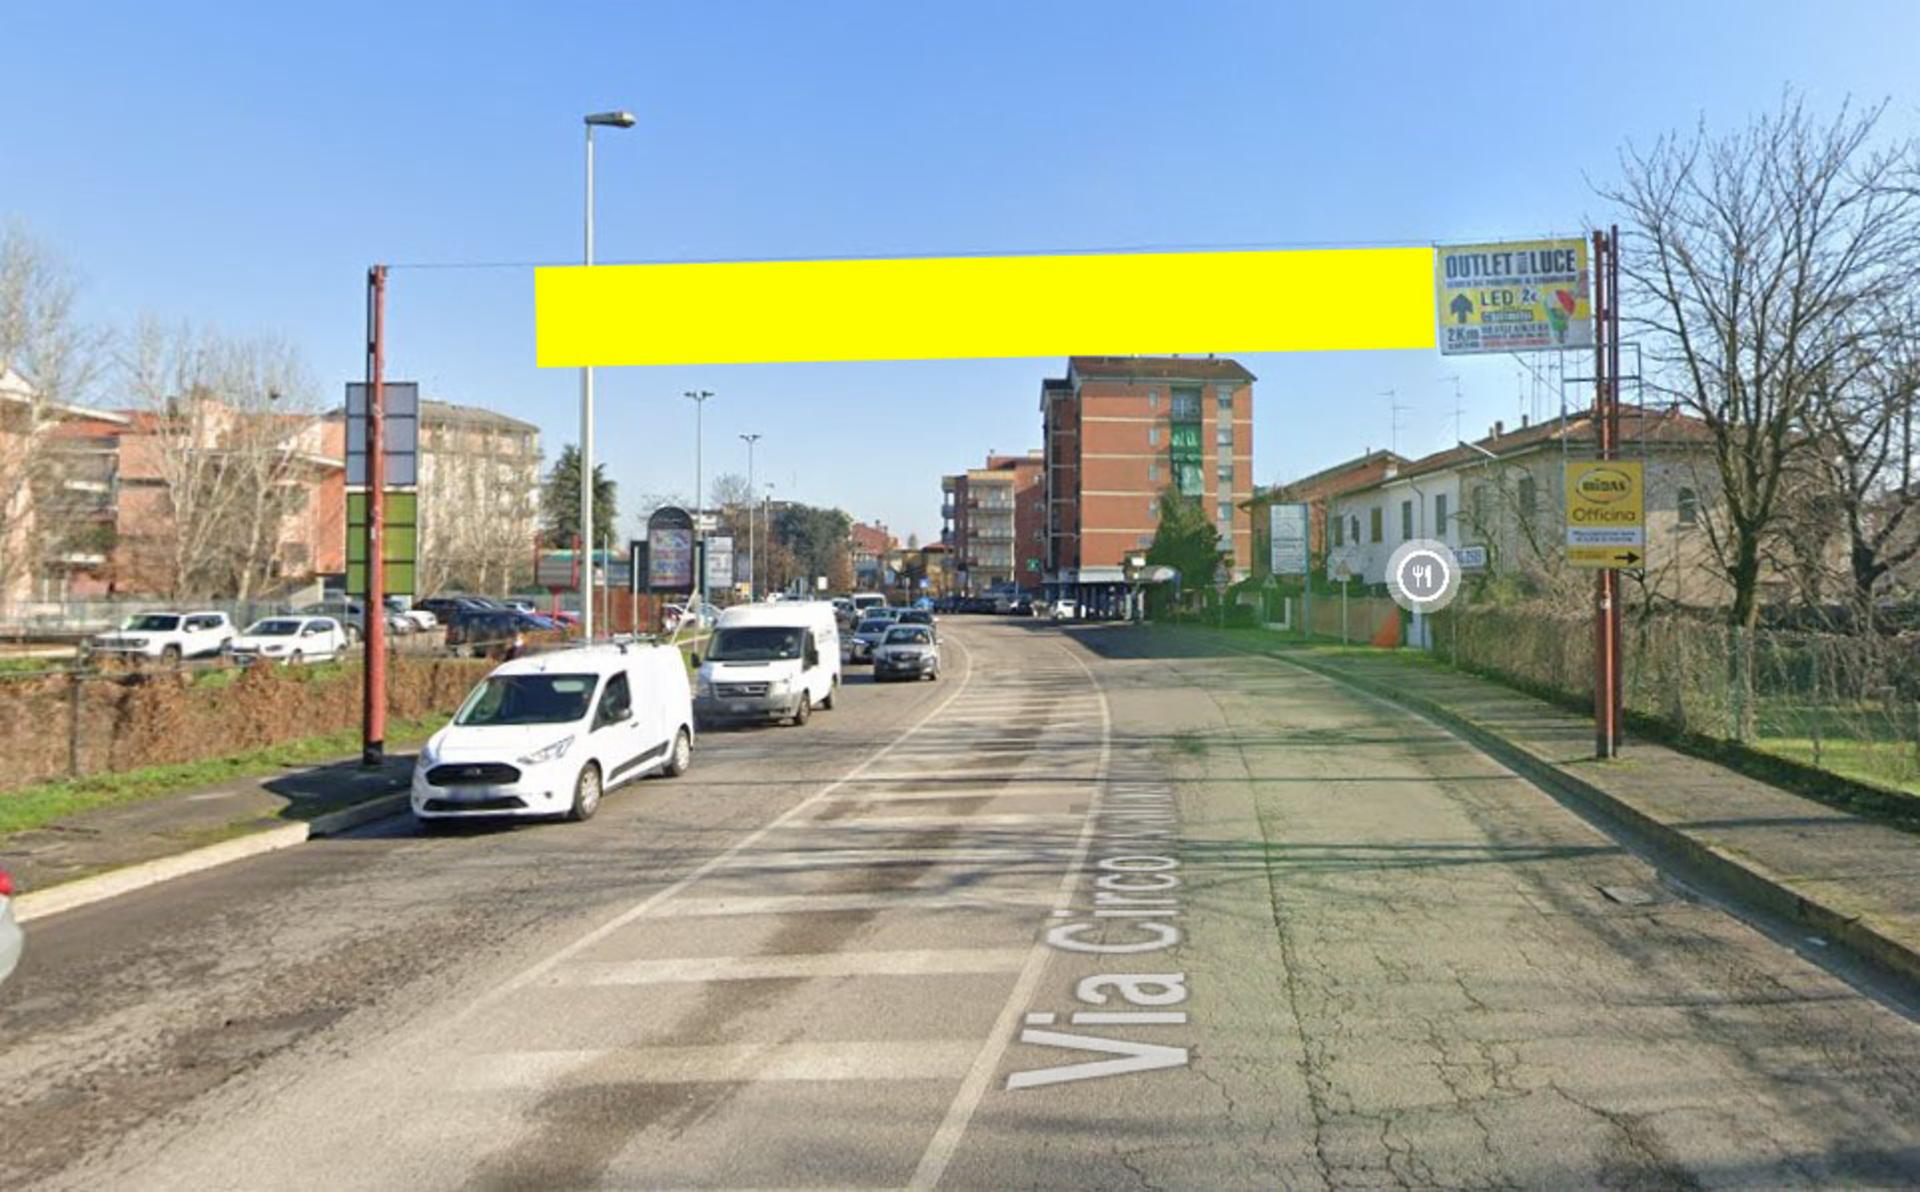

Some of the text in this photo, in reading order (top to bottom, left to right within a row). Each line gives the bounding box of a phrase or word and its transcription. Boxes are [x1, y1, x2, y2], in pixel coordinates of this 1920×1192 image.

[1446, 253, 1513, 278] OUTLET
[1531, 250, 1576, 274] LUCE
[1481, 291, 1513, 306] LED
[1572, 507, 1636, 522] Officina
